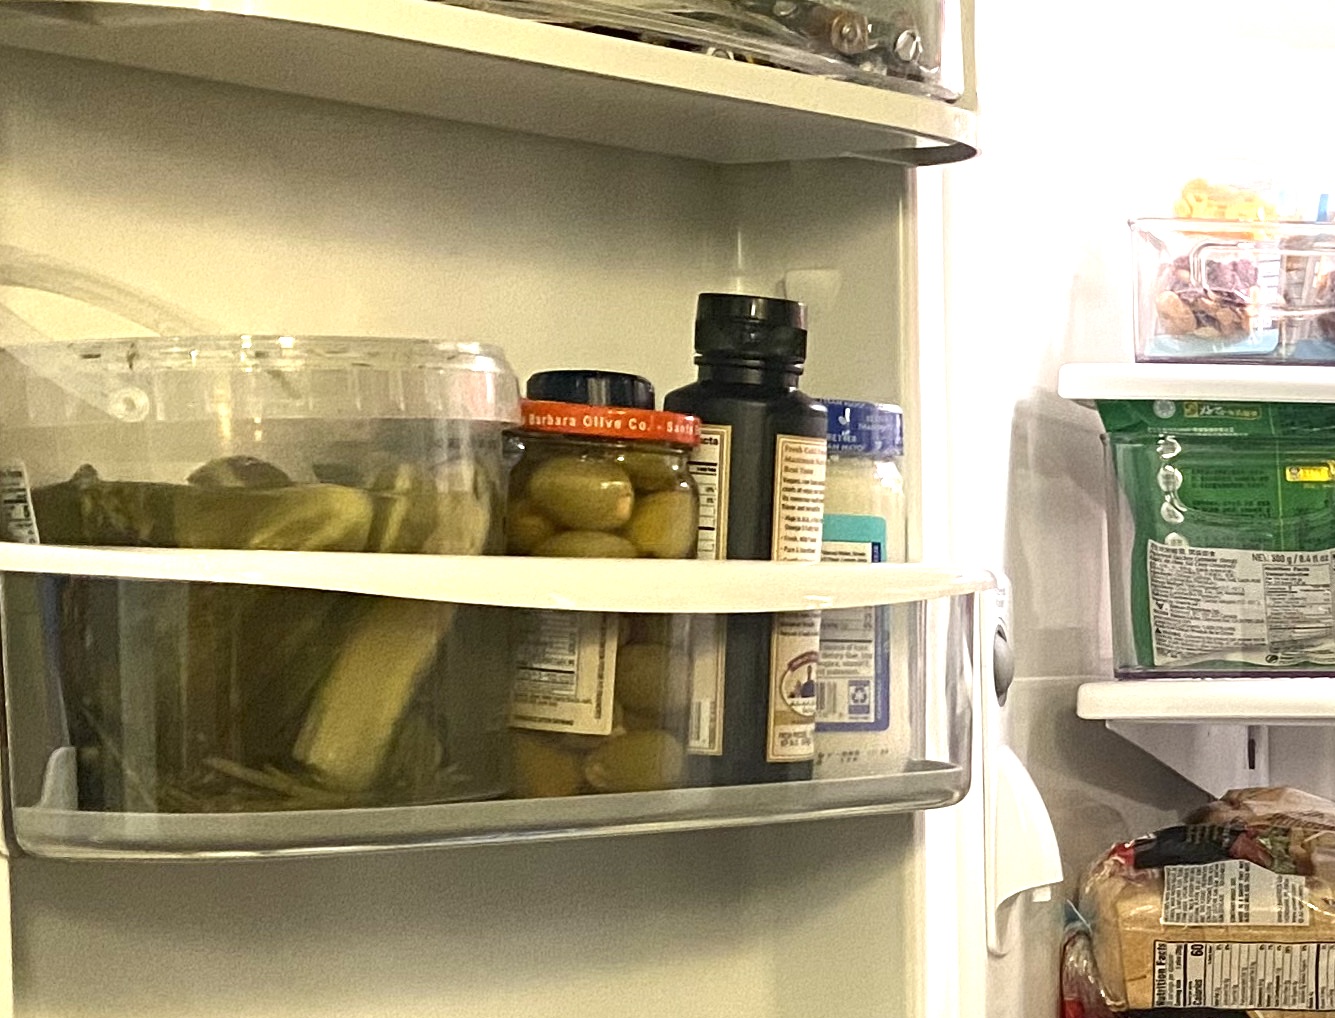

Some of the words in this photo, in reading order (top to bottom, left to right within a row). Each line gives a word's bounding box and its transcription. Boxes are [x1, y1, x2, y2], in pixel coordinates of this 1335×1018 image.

[529, 414, 576, 426] Barbara
[583, 415, 621, 428] Olive
[629, 418, 650, 431] Co.
[1156, 943, 1167, 965] Facts
[1190, 944, 1204, 957] 60
[1156, 968, 1166, 1006] Nutrition
